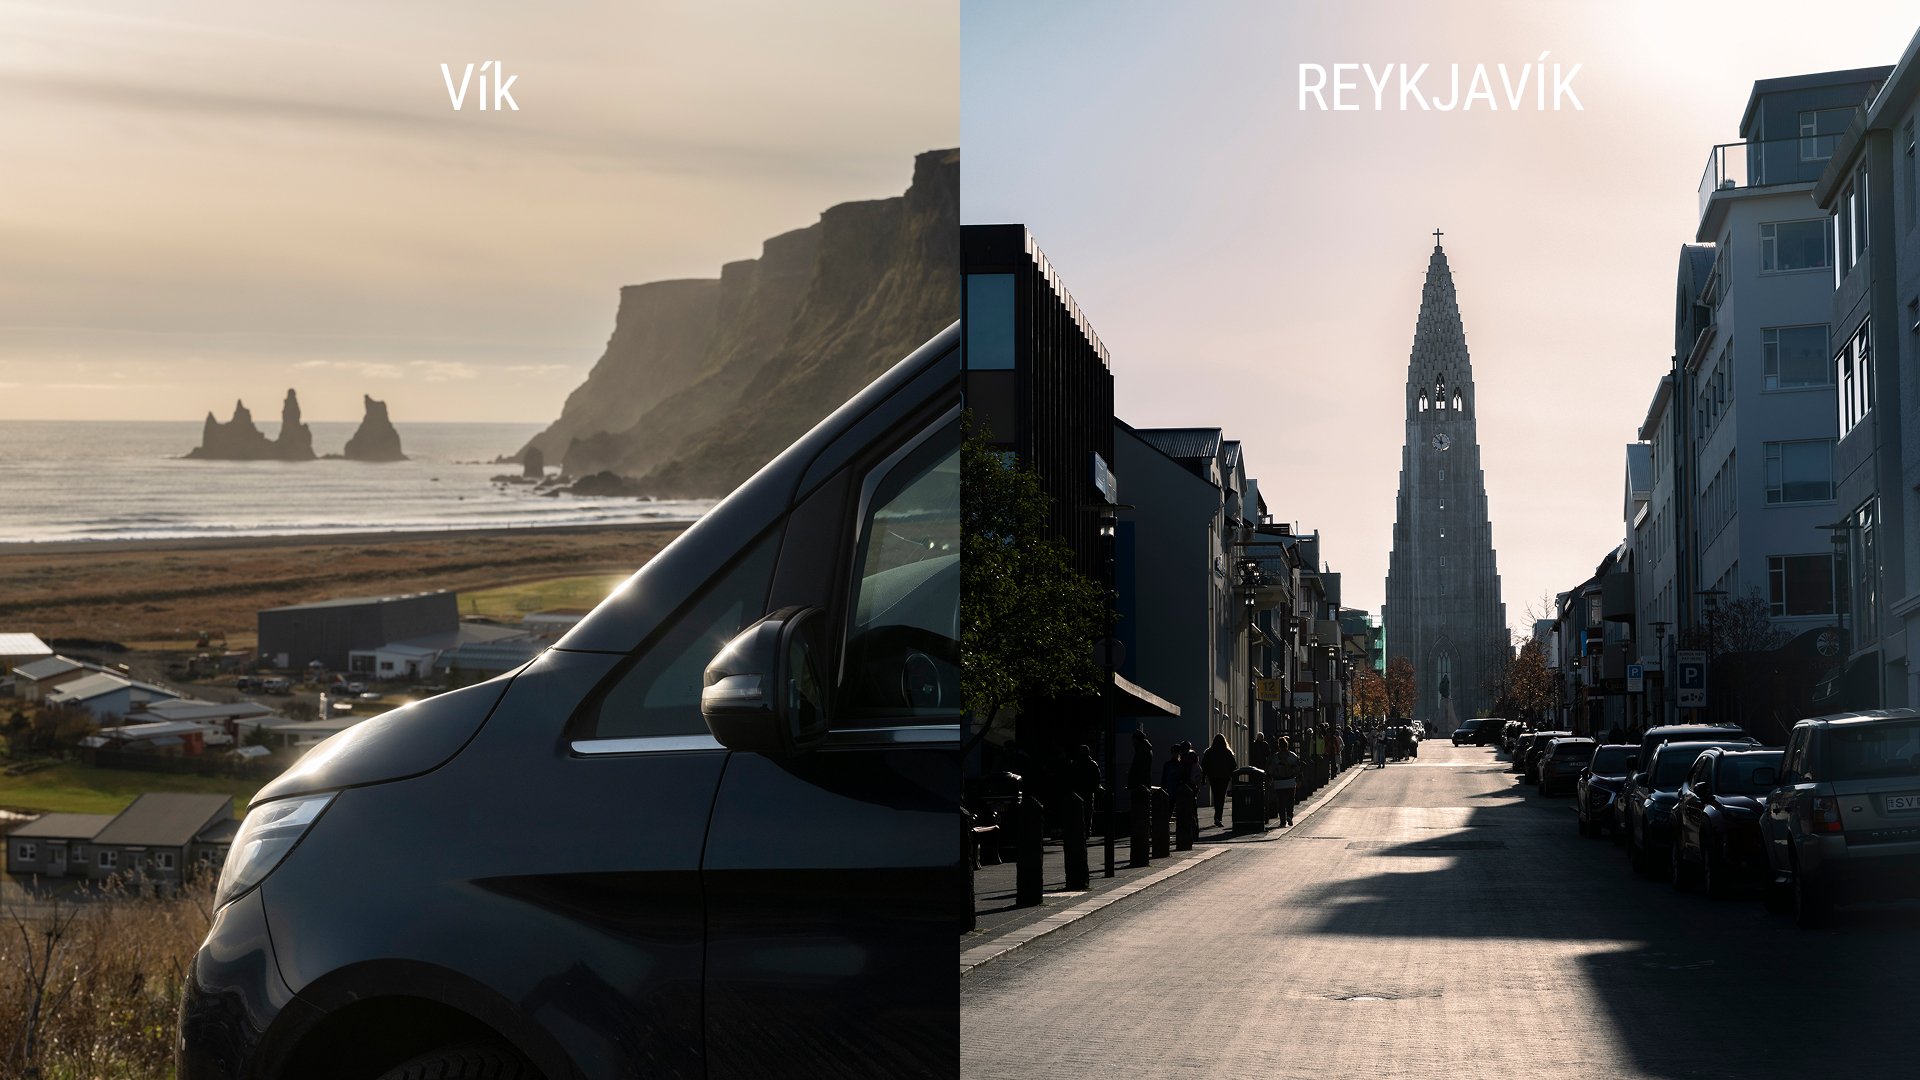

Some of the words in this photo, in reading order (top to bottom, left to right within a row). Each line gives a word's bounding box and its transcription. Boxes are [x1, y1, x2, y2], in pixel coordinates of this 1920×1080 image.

[1631, 668, 1639, 676] P
[1686, 667, 1698, 684] P
[1263, 681, 1275, 692] 12
